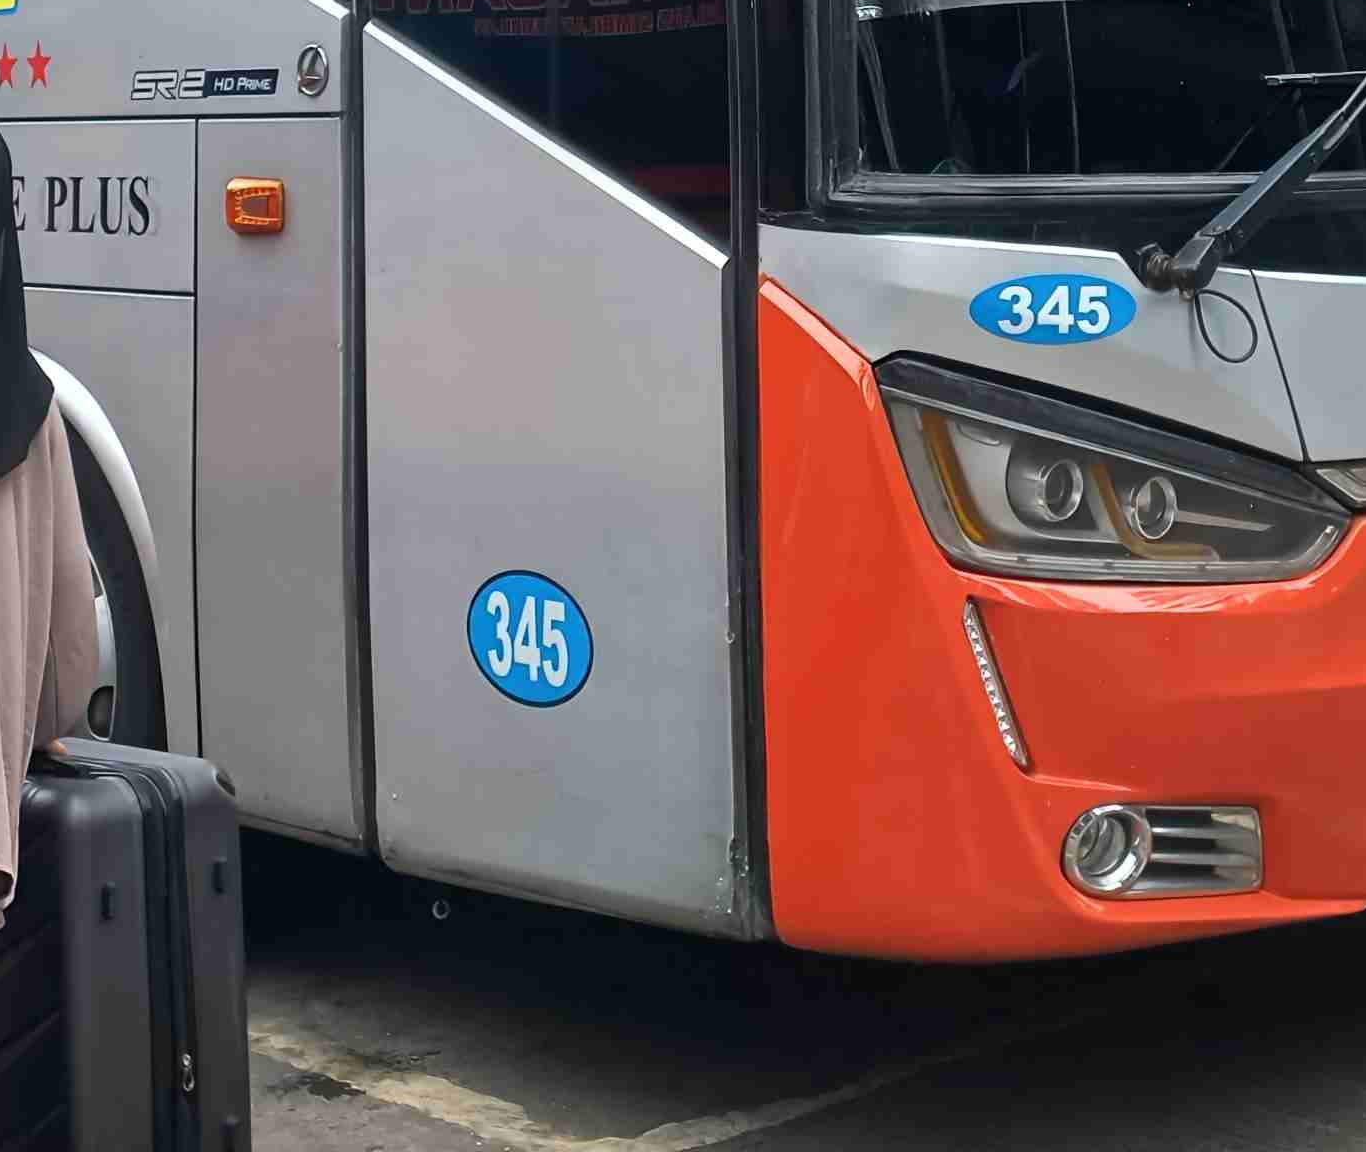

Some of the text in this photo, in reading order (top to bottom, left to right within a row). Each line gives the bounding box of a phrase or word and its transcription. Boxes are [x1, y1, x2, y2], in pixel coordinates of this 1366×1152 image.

[131, 68, 205, 100] SR2
[213, 77, 234, 91] HD
[44, 175, 150, 236] PLUS
[997, 285, 1111, 336] 345
[487, 590, 570, 688] 345
